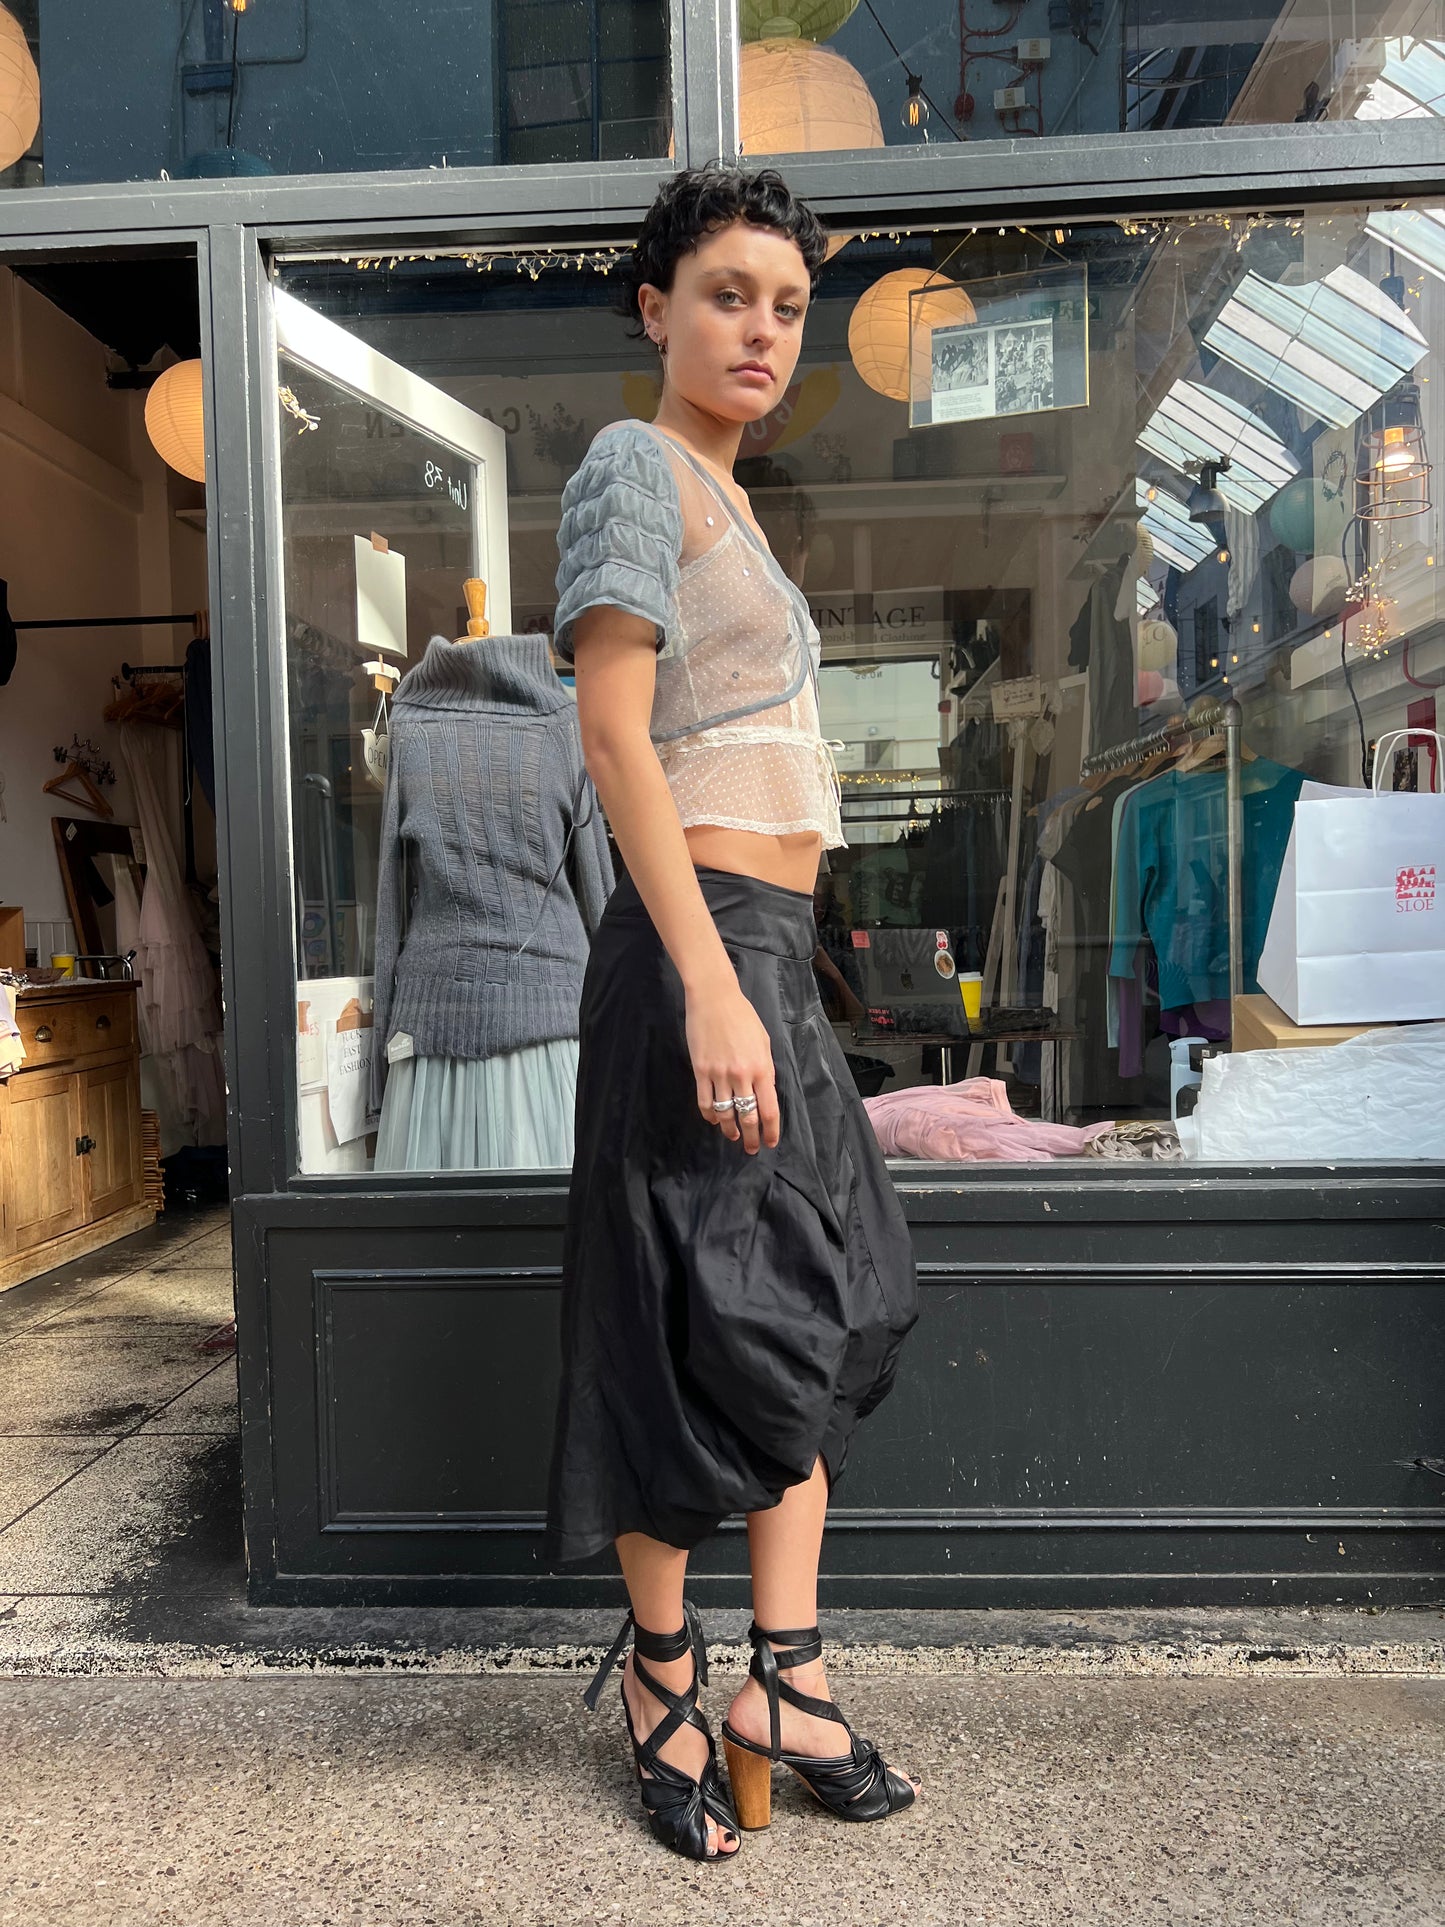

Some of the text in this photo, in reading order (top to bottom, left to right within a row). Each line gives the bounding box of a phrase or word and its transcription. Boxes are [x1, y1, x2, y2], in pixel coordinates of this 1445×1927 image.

[1396, 898, 1434, 913] SLOE
[343, 1044, 362, 1058] FAST
[339, 1056, 372, 1075] FASHION
